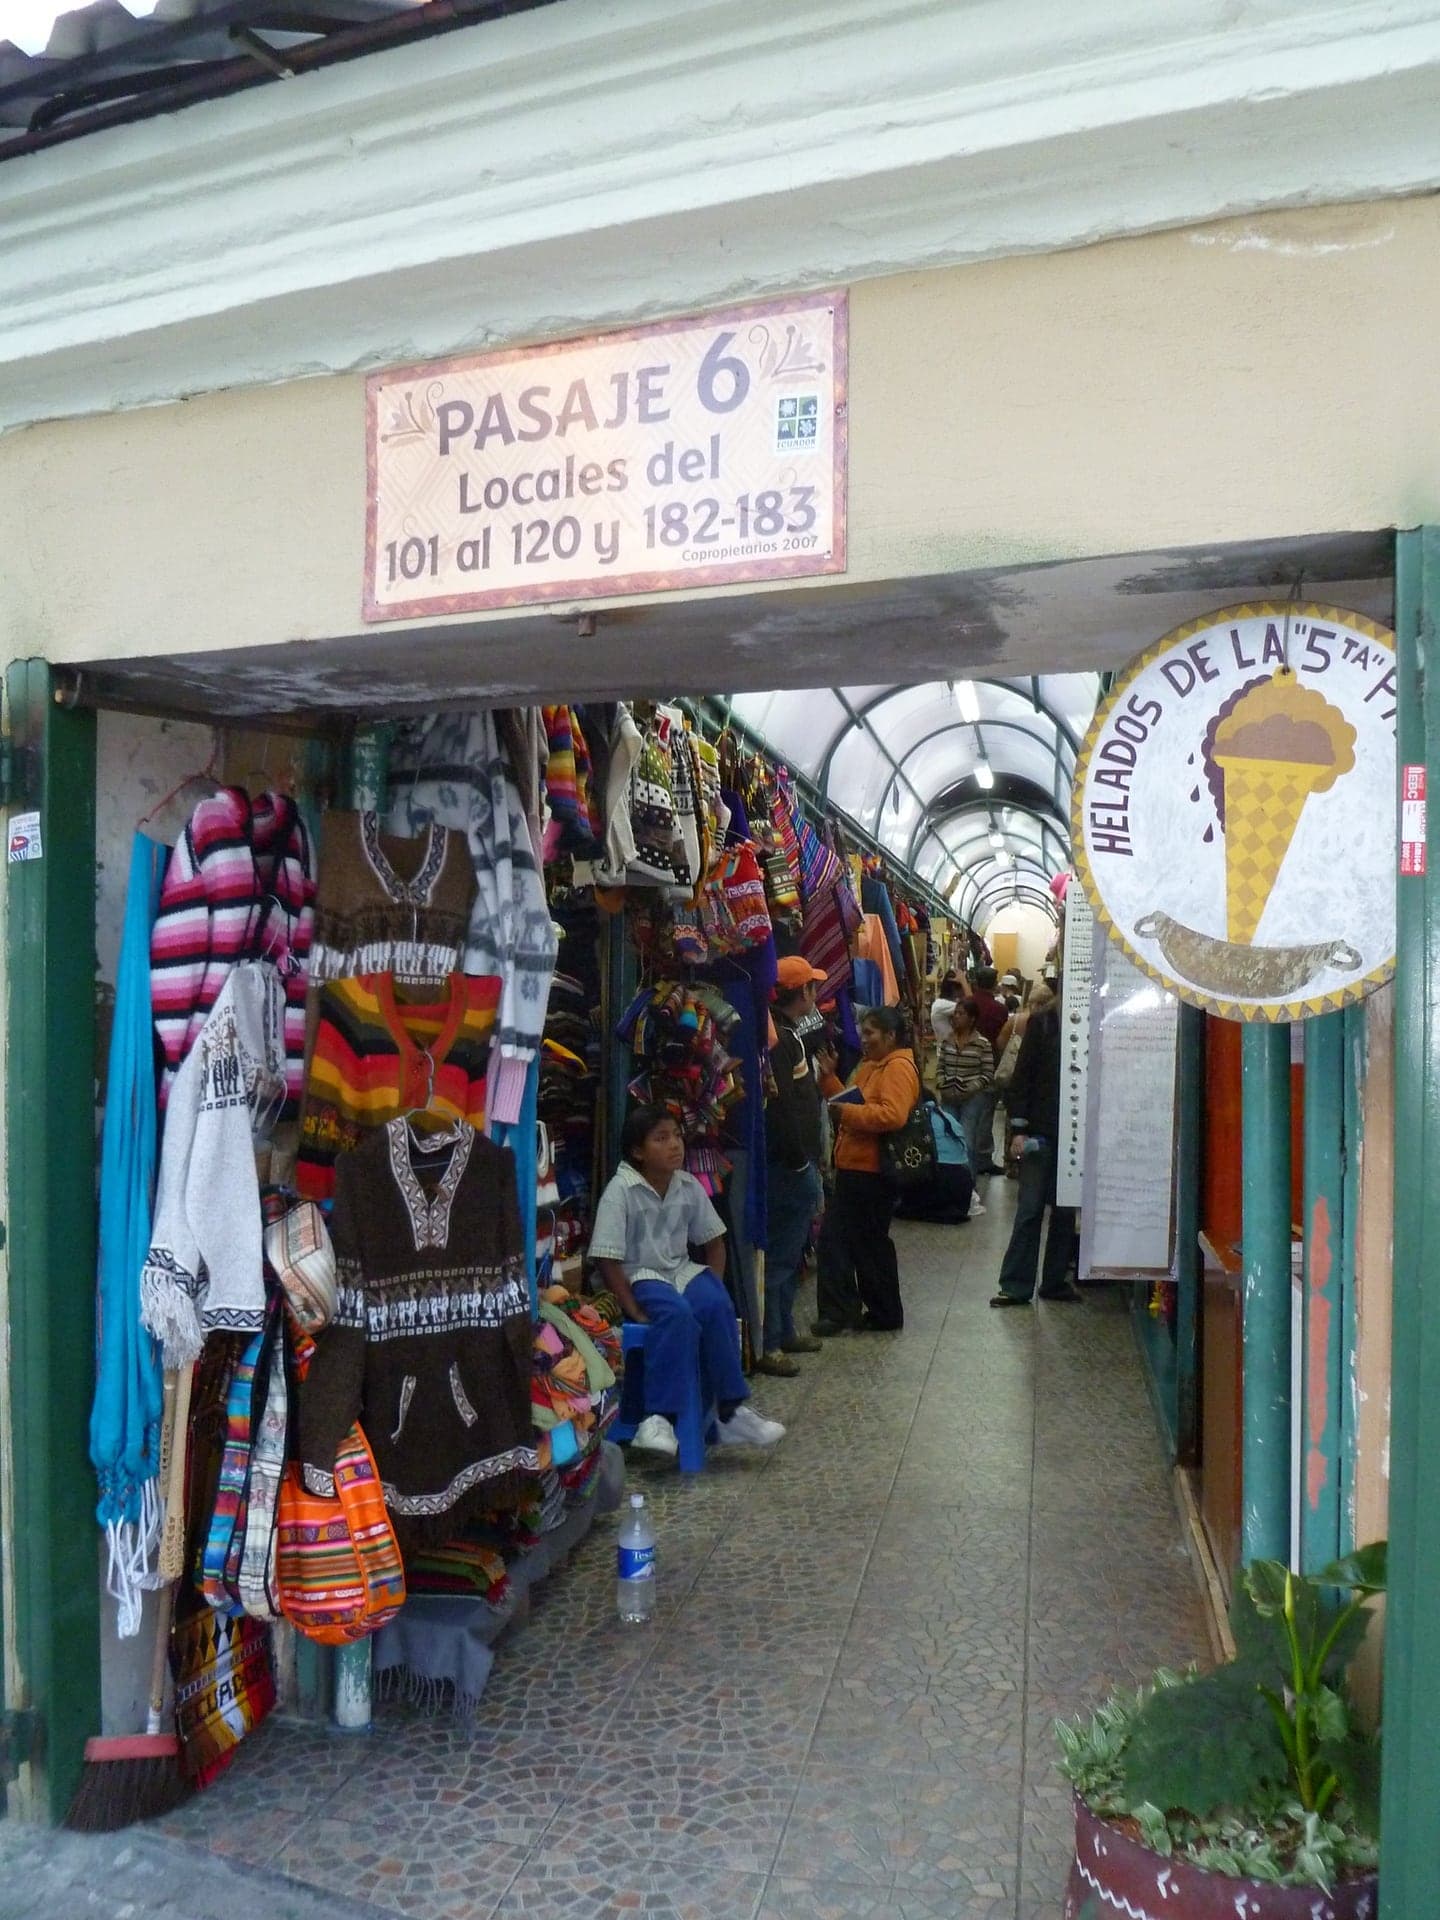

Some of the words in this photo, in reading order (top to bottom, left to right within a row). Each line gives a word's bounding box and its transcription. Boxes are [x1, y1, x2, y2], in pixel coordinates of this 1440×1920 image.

[436, 364, 671, 457] PASAJE
[697, 332, 750, 414] 6
[459, 454, 629, 514] Locales
[646, 433, 720, 487] del
[385, 534, 439, 582] 101
[456, 526, 491, 572] al
[511, 516, 582, 565] 120
[594, 520, 620, 565] y
[643, 486, 817, 549] 182-183
[682, 542, 777, 563] Copropietarios
[783, 535, 818, 551] 2007
[1090, 694, 1163, 857] HELADOS
[1160, 640, 1221, 698] DE
[1230, 623, 1285, 670] LA
